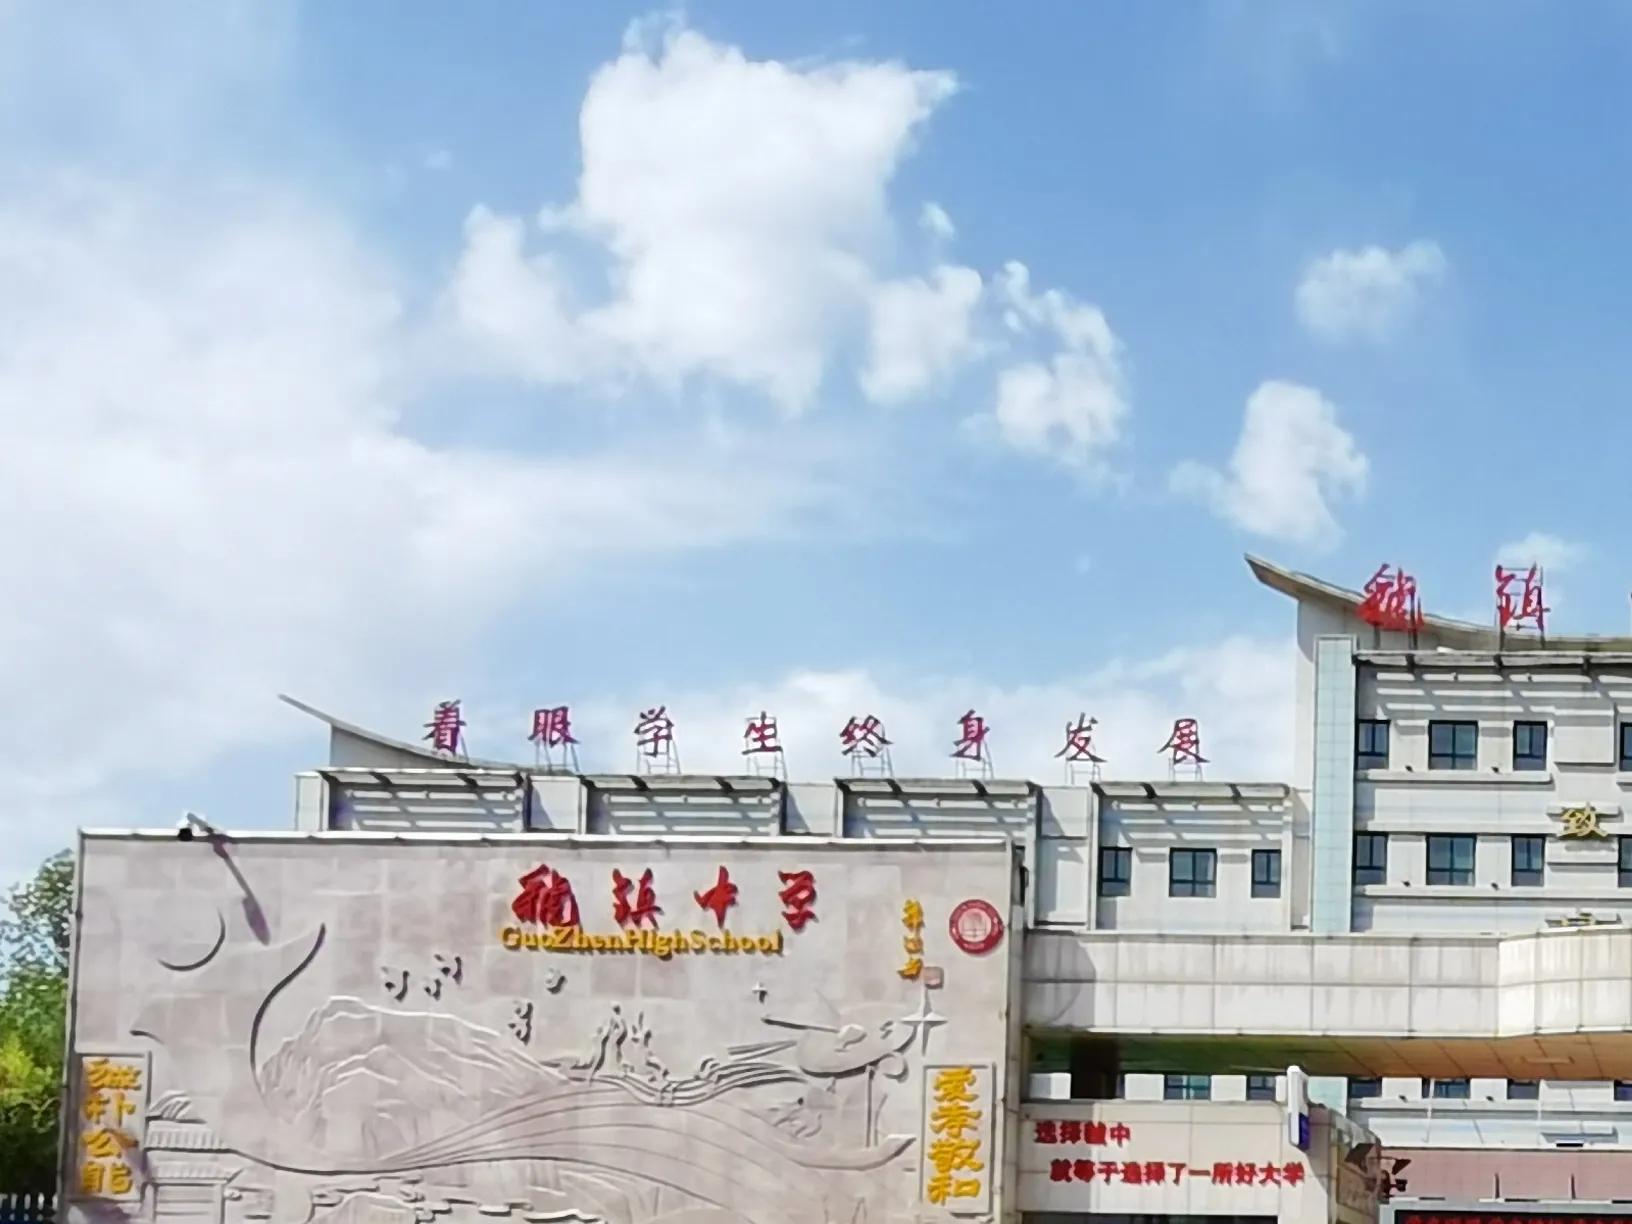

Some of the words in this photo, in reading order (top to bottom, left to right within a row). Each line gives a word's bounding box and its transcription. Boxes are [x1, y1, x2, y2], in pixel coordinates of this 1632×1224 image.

[423, 700, 1211, 764] 着眼学生终身发展
[1050, 1158, 1305, 1188] 就等于选择了一所好大学
